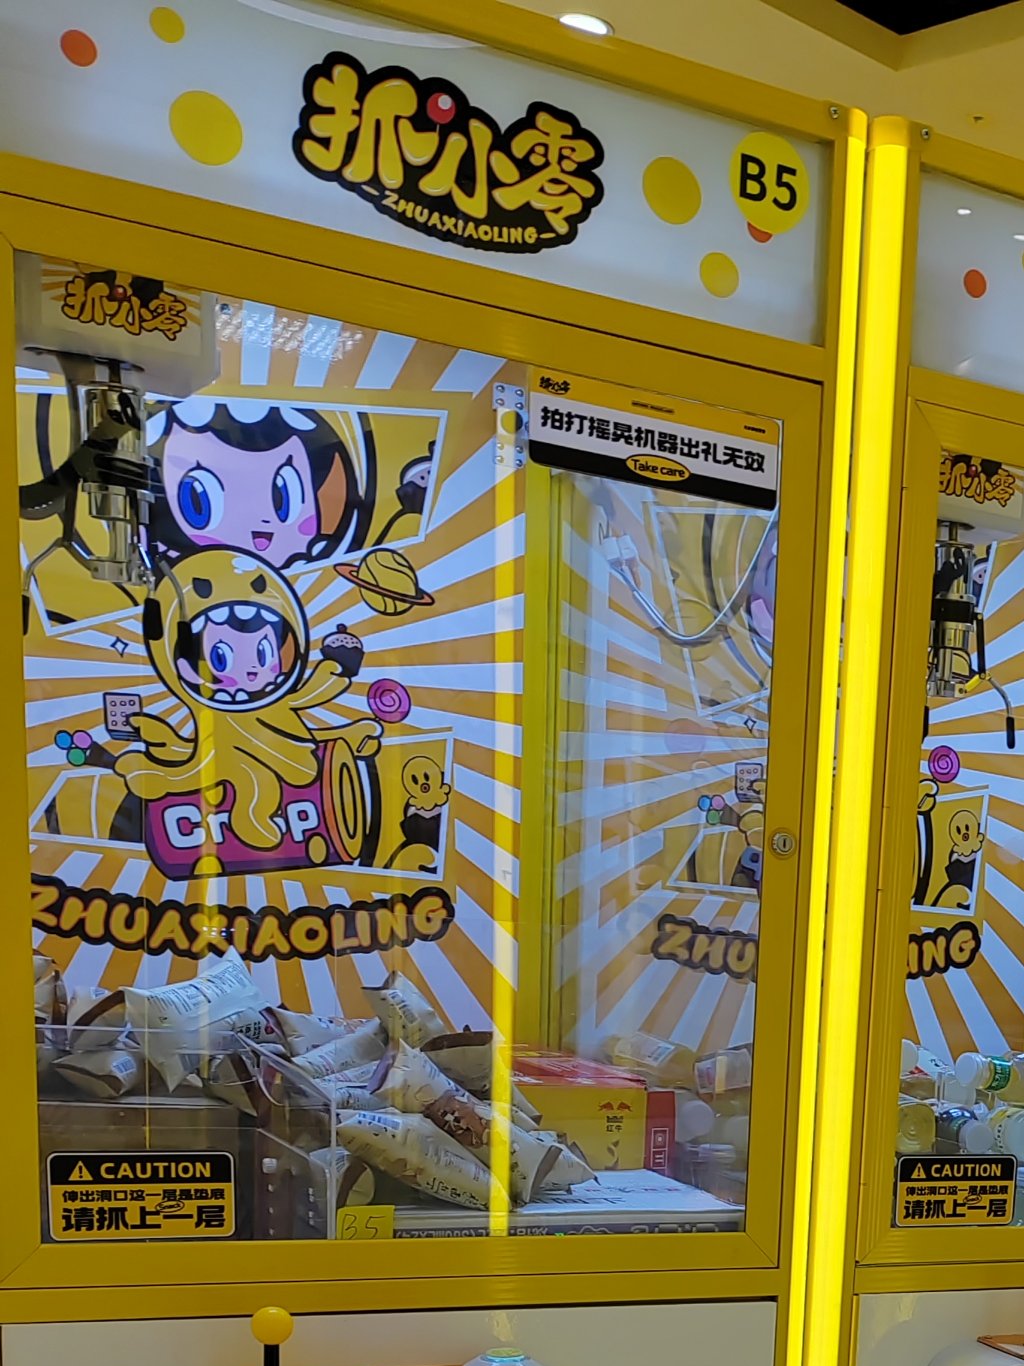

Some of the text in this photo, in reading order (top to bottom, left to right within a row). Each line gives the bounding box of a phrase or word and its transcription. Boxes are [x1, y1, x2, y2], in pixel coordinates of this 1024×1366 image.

[302, 64, 596, 235] 抓小零
[739, 153, 797, 212] B5
[380, 190, 540, 245] ZHUAXIAOLING
[62, 274, 187, 341] 抓小零
[541, 406, 765, 473] 拍打摇晃机器出礼无效
[631, 458, 685, 478] Take care
[32, 885, 448, 956] ZHUAXIAOLING
[100, 1162, 212, 1179] CAUTION
[931, 1163, 1002, 1178] CAUTION
[62, 1188, 226, 1203] 伸出洞口这一层是垫底
[903, 1199, 1007, 1219] 请抓上一层
[62, 1204, 226, 1232] 请抓上一层
